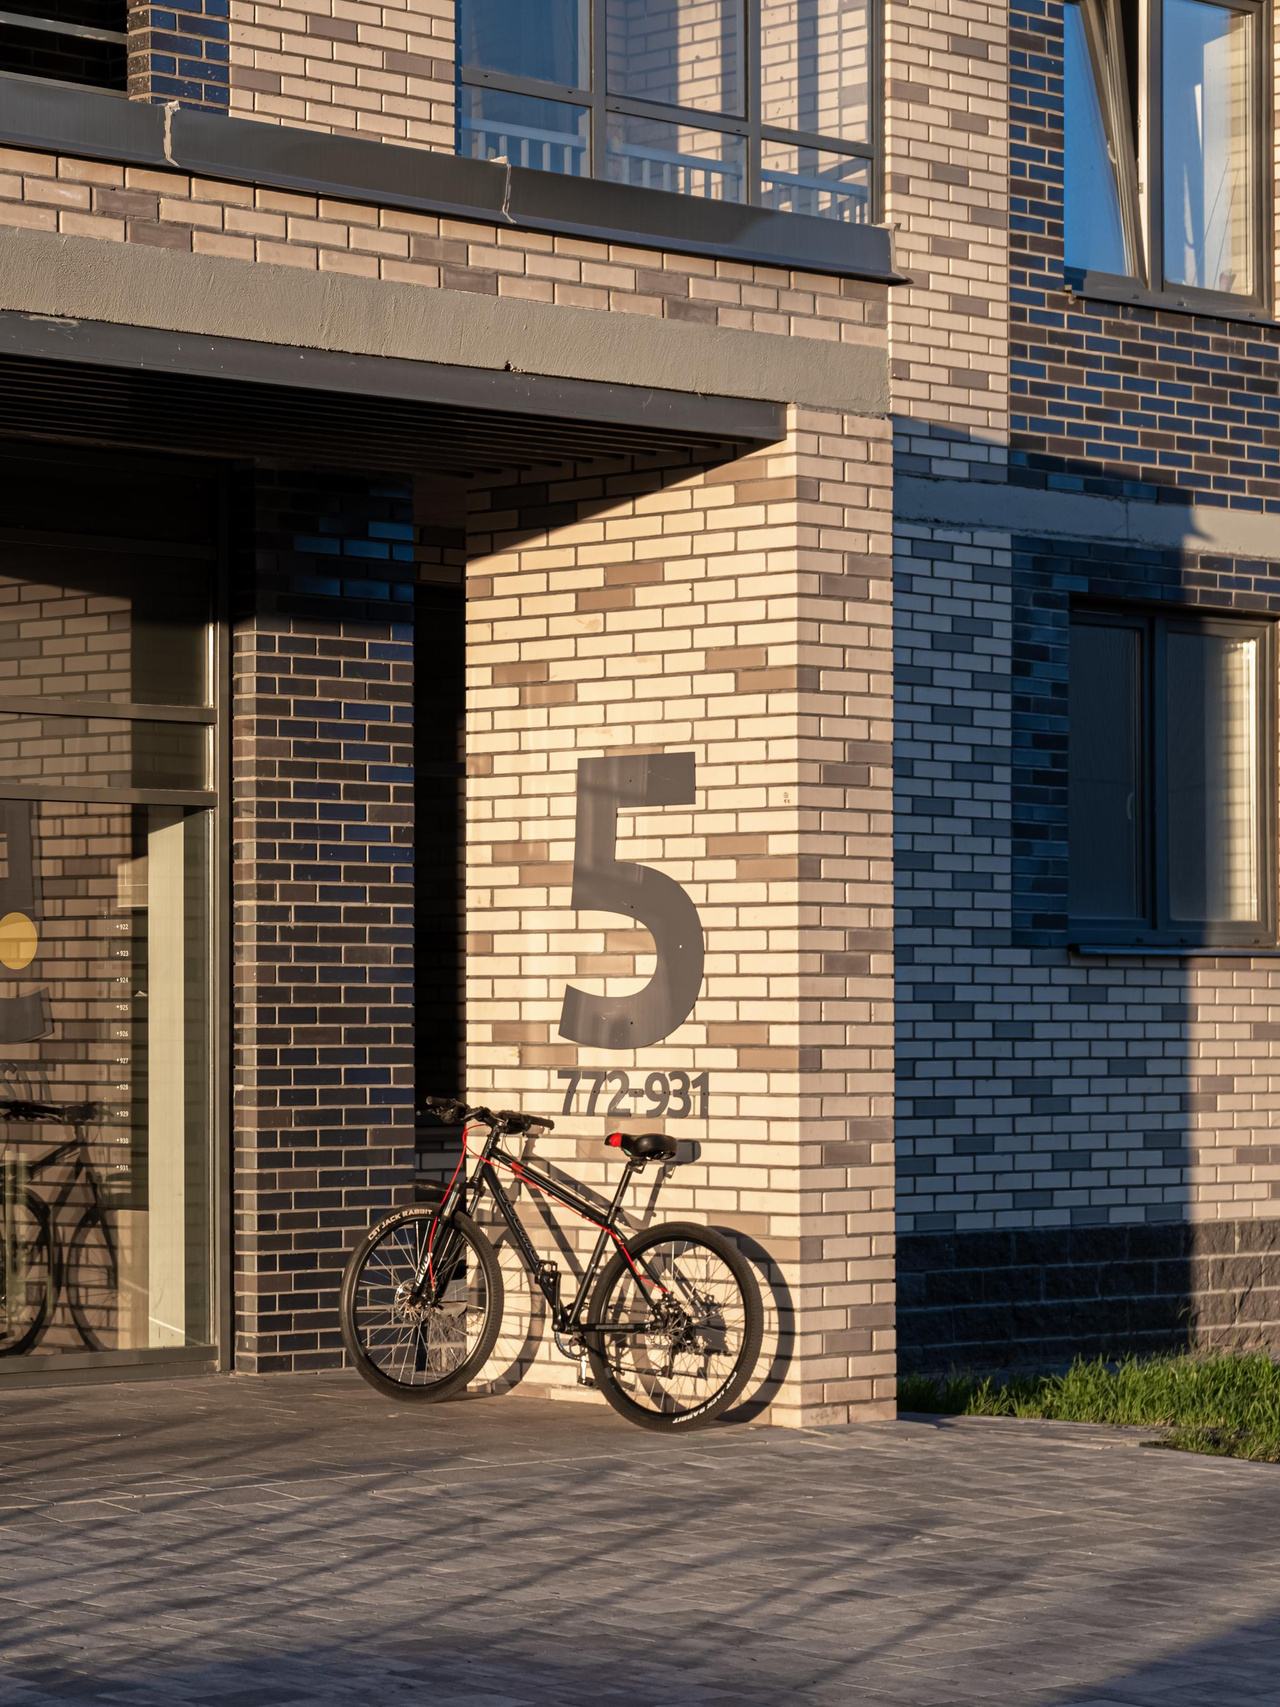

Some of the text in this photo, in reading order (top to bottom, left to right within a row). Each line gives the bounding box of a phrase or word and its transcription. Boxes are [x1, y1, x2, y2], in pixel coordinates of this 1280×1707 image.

[558, 752, 705, 1050] 5
[558, 1070, 710, 1119] 772-931
[367, 1208, 433, 1241] CST JACK RABBIT
[672, 1406, 706, 1424] RABBIT
